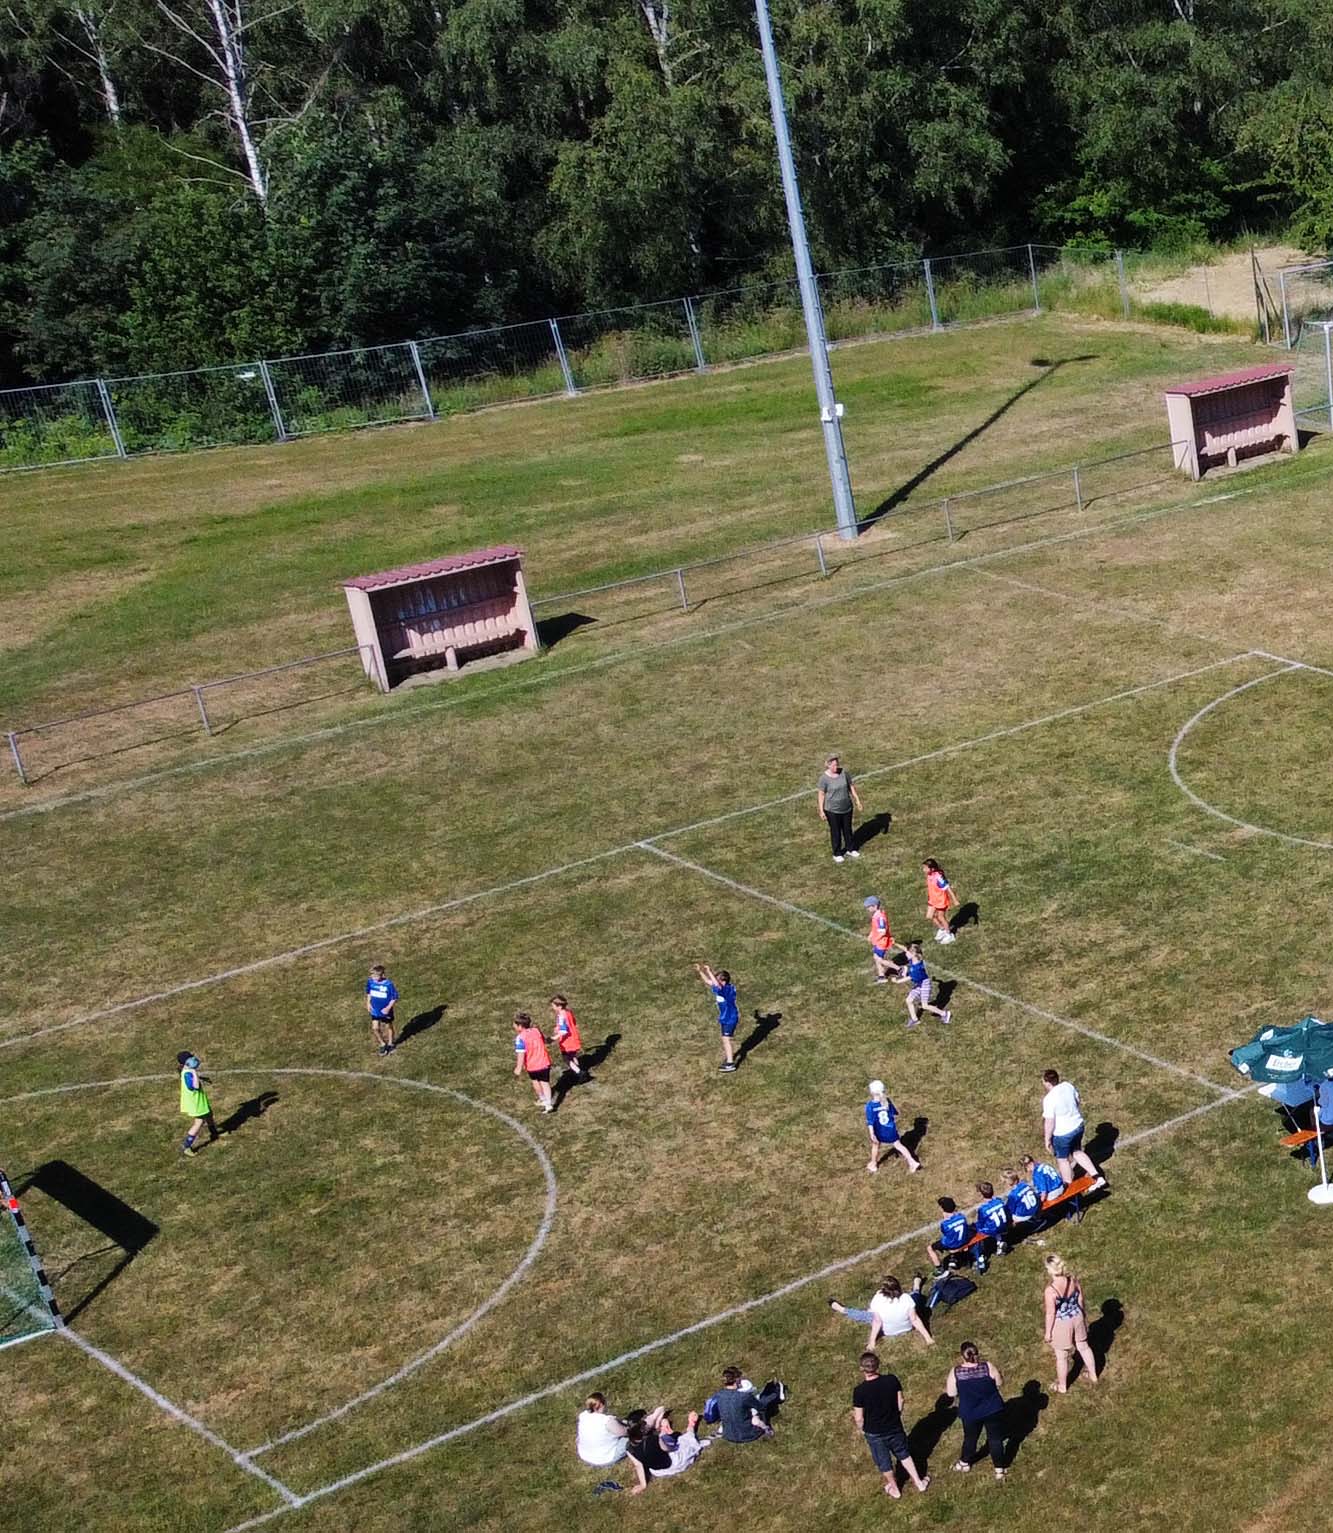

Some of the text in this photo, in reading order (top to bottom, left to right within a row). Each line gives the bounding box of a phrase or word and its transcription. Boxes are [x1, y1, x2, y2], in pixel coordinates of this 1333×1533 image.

[878, 1110, 889, 1125] 8
[1021, 1190, 1037, 1210] 16
[990, 1207, 1007, 1227] 11
[954, 1225, 964, 1240] 7
